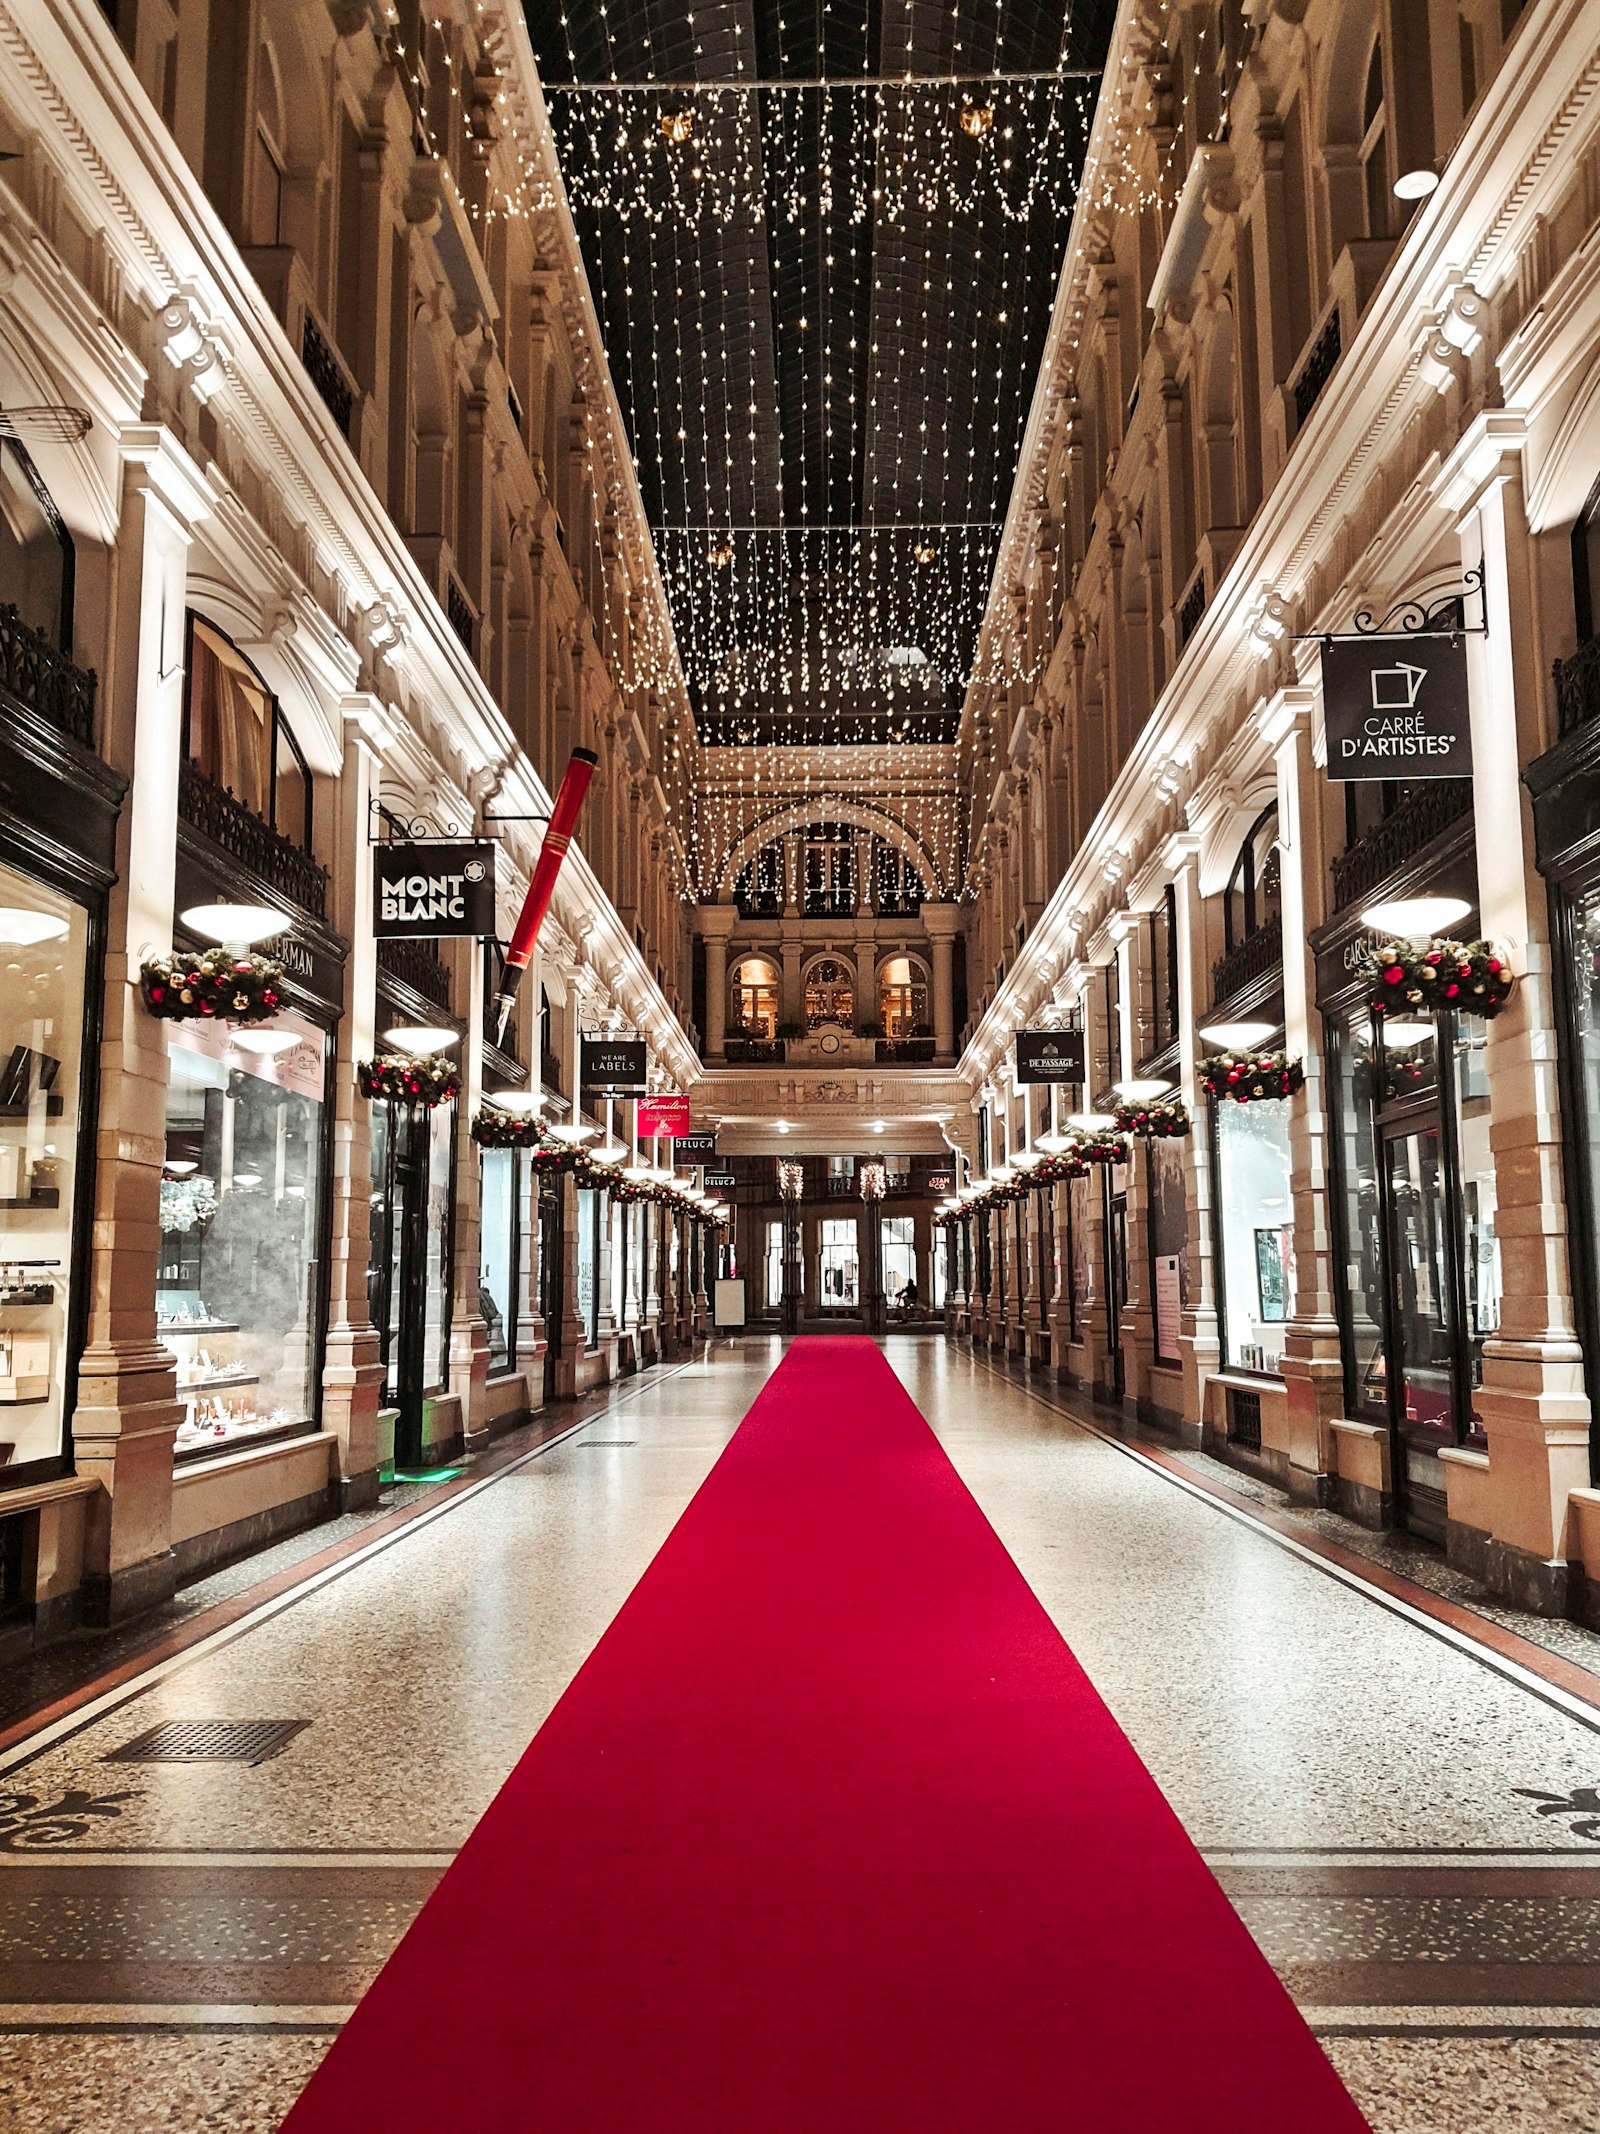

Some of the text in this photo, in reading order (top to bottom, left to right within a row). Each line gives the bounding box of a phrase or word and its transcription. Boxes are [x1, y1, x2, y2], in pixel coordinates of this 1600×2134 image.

[1364, 711, 1425, 736] CARRÉ
[381, 874, 465, 898] MONT
[381, 896, 465, 920] BLANC
[591, 1062, 636, 1071] LABELS
[1029, 1059, 1073, 1067] DE PASSAGE
[638, 1099, 688, 1110] Hamilton
[675, 1140, 713, 1148] DELUCA
